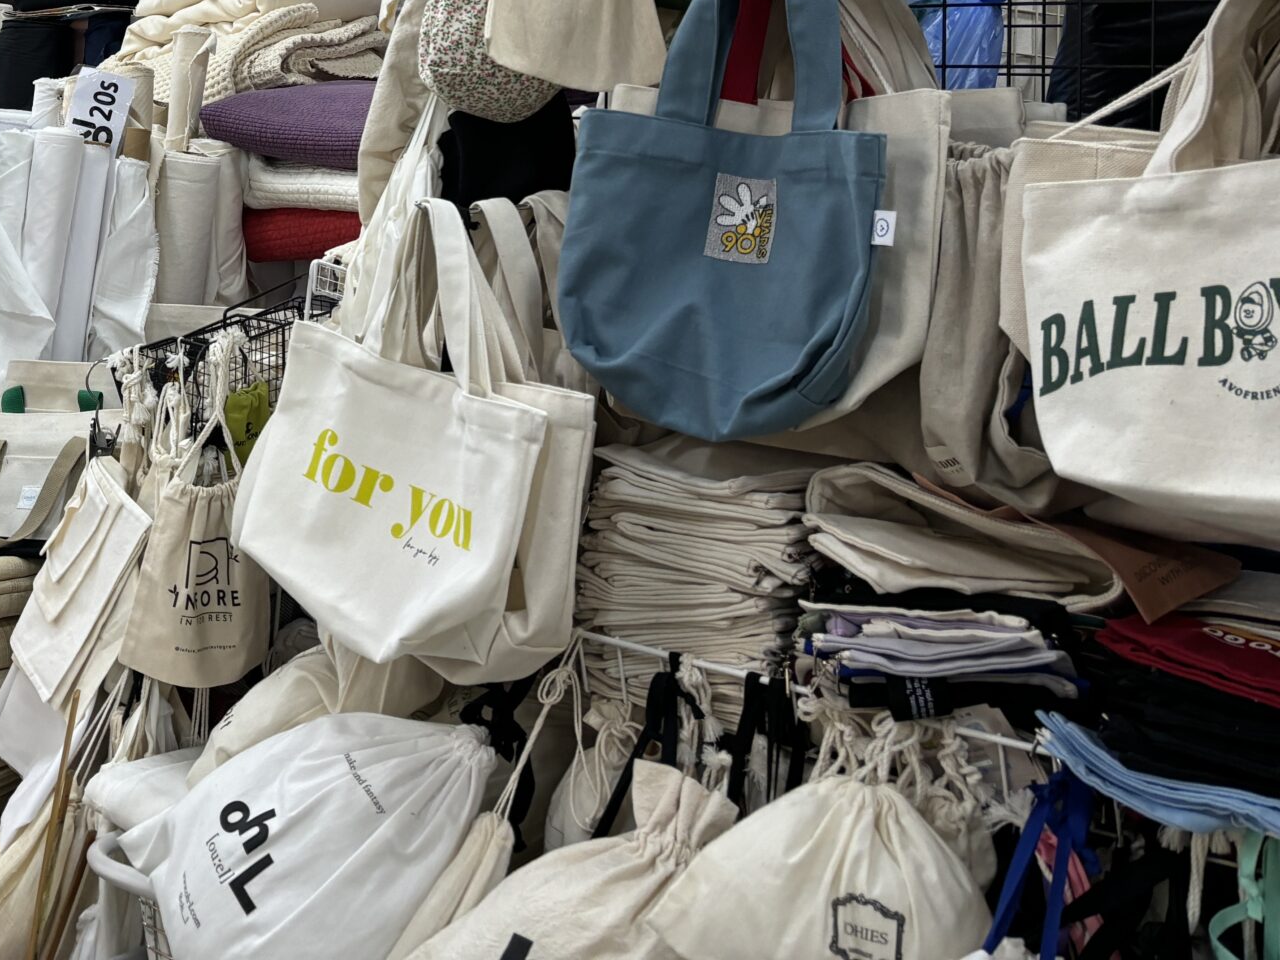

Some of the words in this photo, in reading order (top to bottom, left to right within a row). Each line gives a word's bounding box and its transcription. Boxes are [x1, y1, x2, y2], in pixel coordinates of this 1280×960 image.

[720, 230, 757, 255] 90
[1040, 290, 1188, 398] BALL
[302, 428, 394, 510] for
[390, 483, 472, 552] you
[363, 784, 386, 815] fantasy
